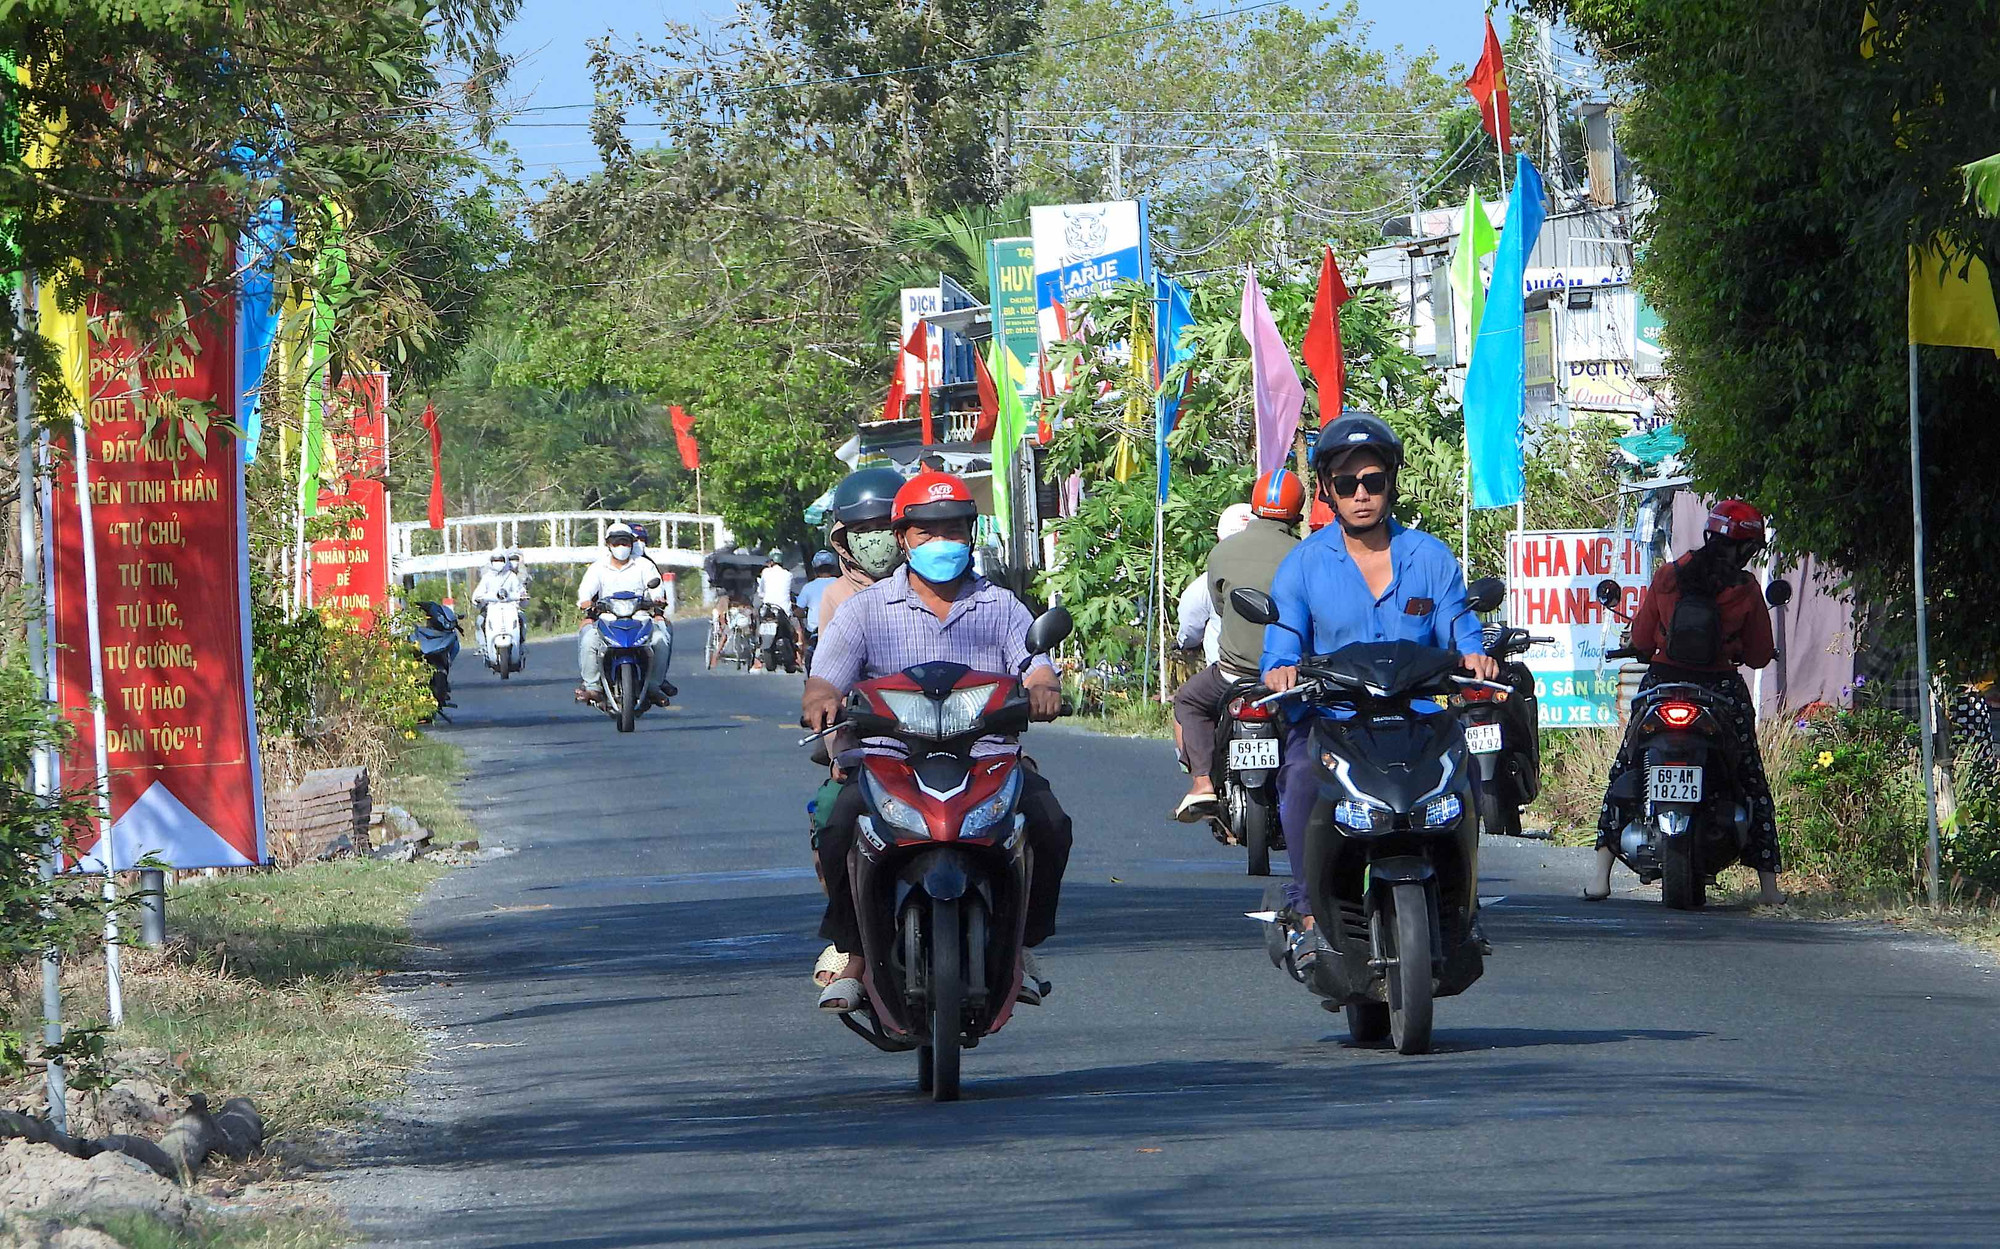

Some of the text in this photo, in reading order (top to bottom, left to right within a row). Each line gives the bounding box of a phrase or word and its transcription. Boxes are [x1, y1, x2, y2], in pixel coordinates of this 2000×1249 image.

[1060, 259, 1118, 291] LARUE
[102, 431, 138, 463] ĐẤT
[127, 480, 166, 504] TINH
[171, 469, 218, 503] THẦN
[148, 512, 186, 548] CHỦ,
[317, 547, 346, 564] NHÂN
[118, 559, 179, 591] TỰ TIN,
[116, 599, 183, 633] TỰ LỰC,
[1510, 587, 1603, 626] THANH
[104, 639, 198, 674] TỰ CƯỜNG,
[121, 680, 186, 715] TỰ HÀO
[1552, 676, 1589, 697] SÂN
[1567, 705, 1592, 722] XE
[1597, 702, 1610, 721] Ô
[107, 723, 145, 754] DÂN
[1237, 741, 1270, 754] 69-F1
[1466, 727, 1494, 740] 69-F1
[1466, 737, 1499, 750] 92.92
[1233, 754, 1276, 768] 241.66
[1653, 784, 1698, 800] 182.26
